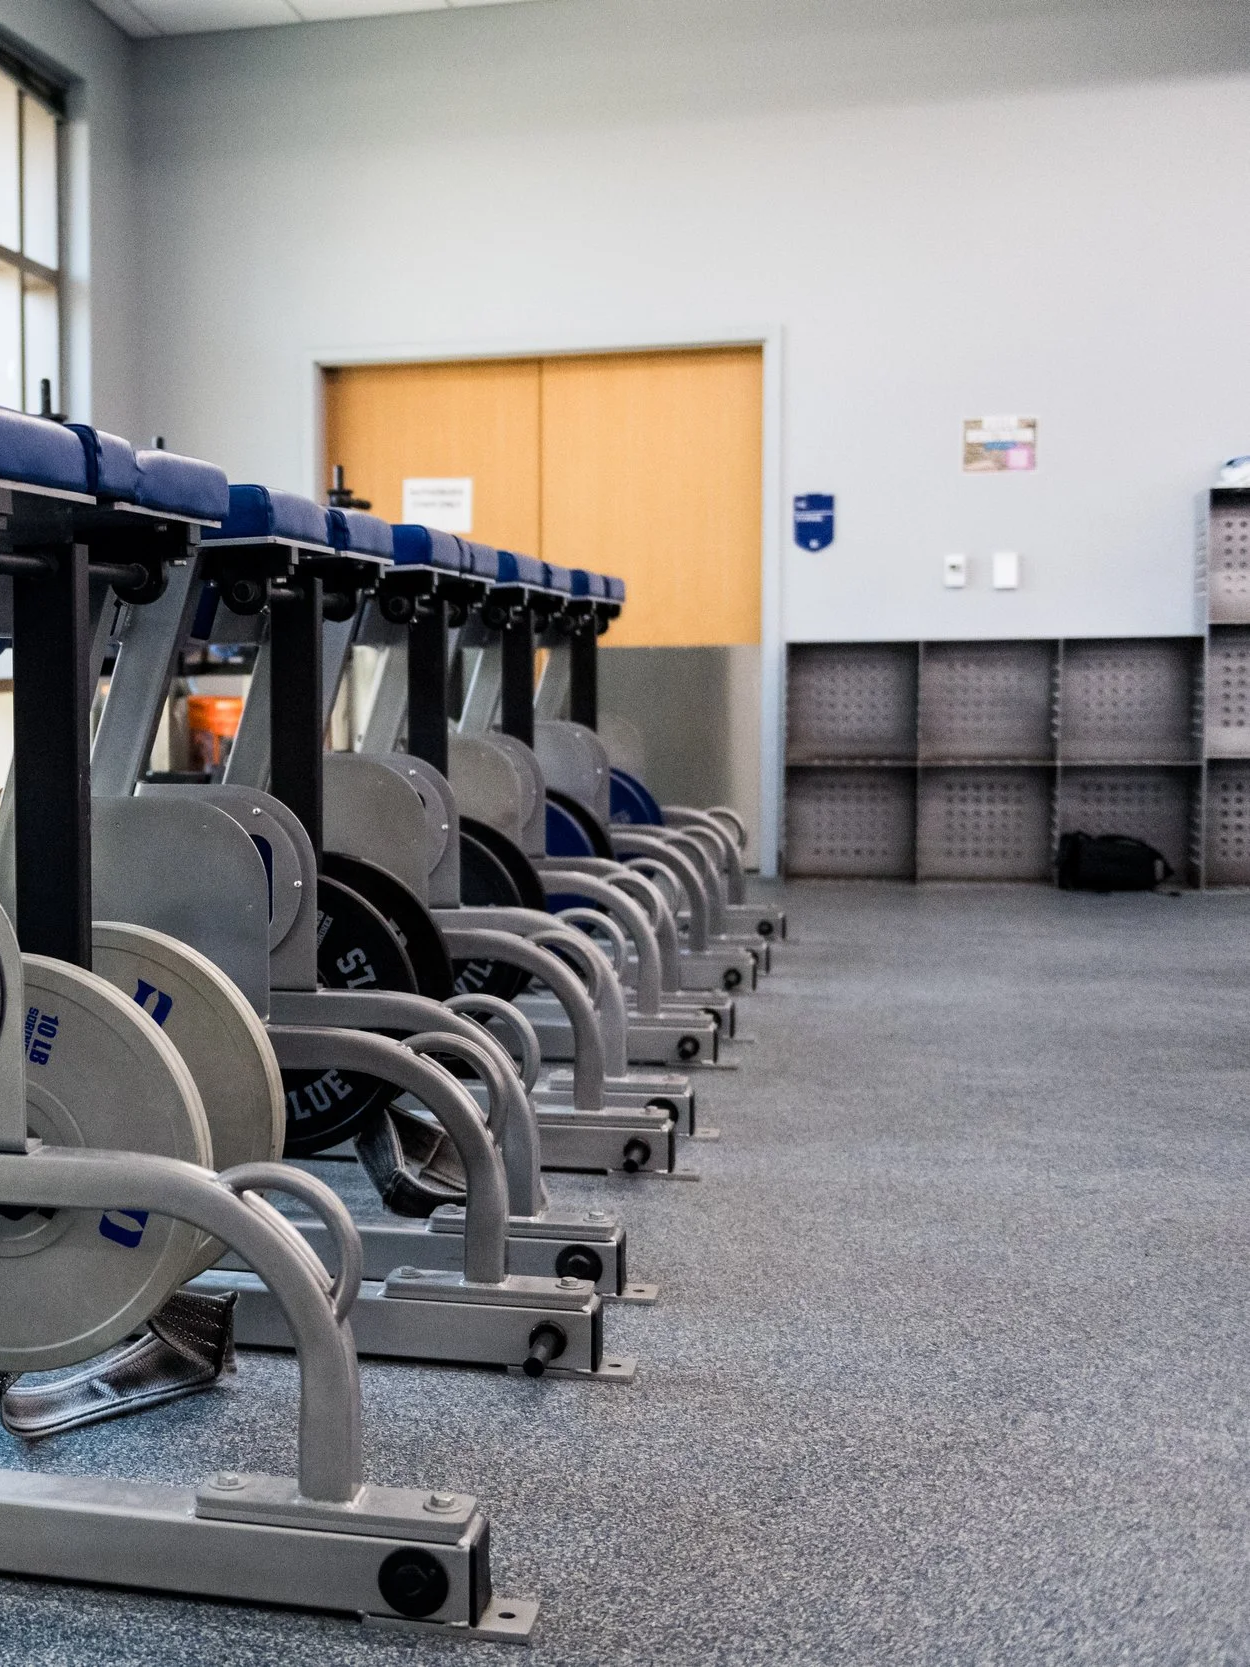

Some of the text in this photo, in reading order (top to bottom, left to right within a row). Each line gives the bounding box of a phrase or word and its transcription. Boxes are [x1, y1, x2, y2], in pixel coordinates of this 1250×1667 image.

[29, 1014, 59, 1066] 10 LB
[285, 1068, 354, 1120] LUE
